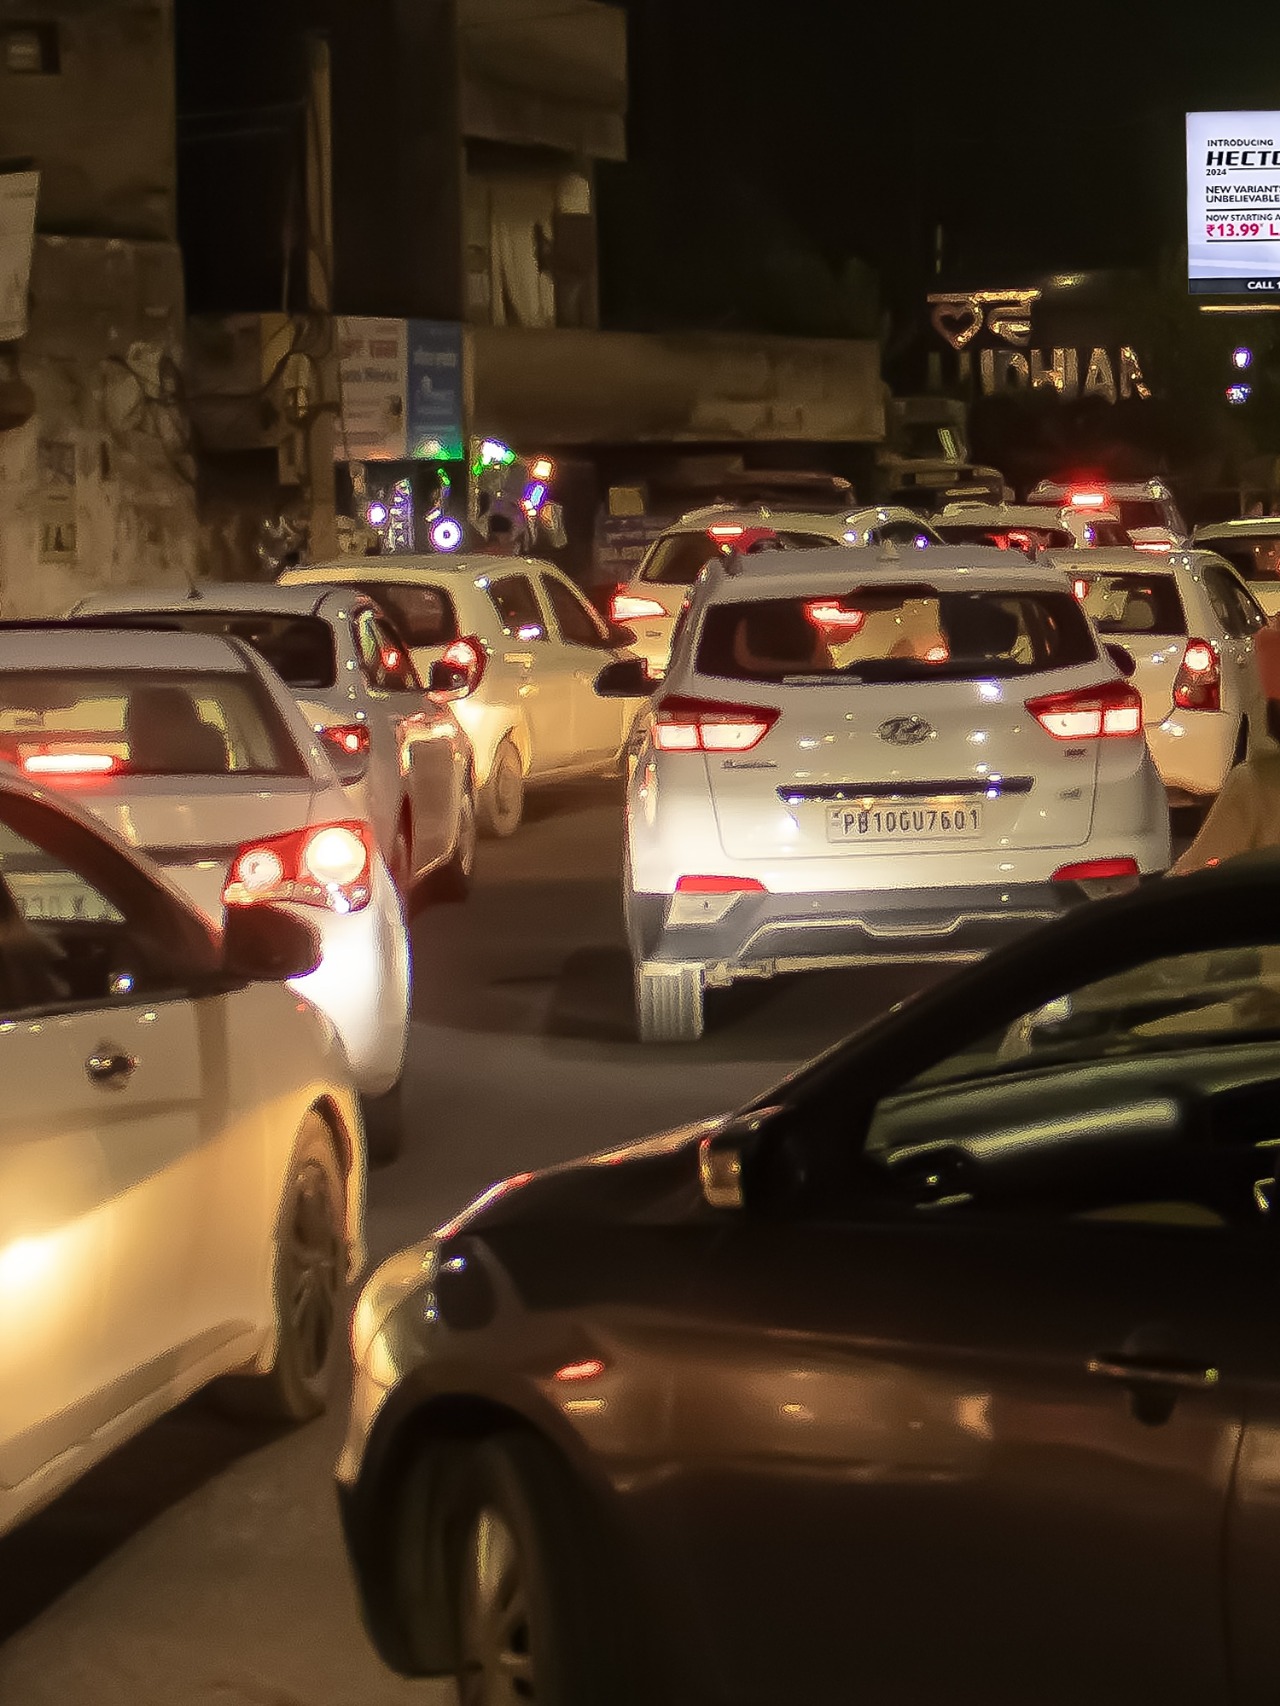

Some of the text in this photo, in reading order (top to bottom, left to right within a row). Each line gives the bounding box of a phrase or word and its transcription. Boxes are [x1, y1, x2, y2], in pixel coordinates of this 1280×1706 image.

[1206, 168, 1227, 176] 2024
[1206, 186, 1232, 194] NEW
[1206, 194, 1280, 203] UNBELIEVABLE
[1206, 214, 1229, 222] NOW
[1247, 281, 1274, 290] CALL
